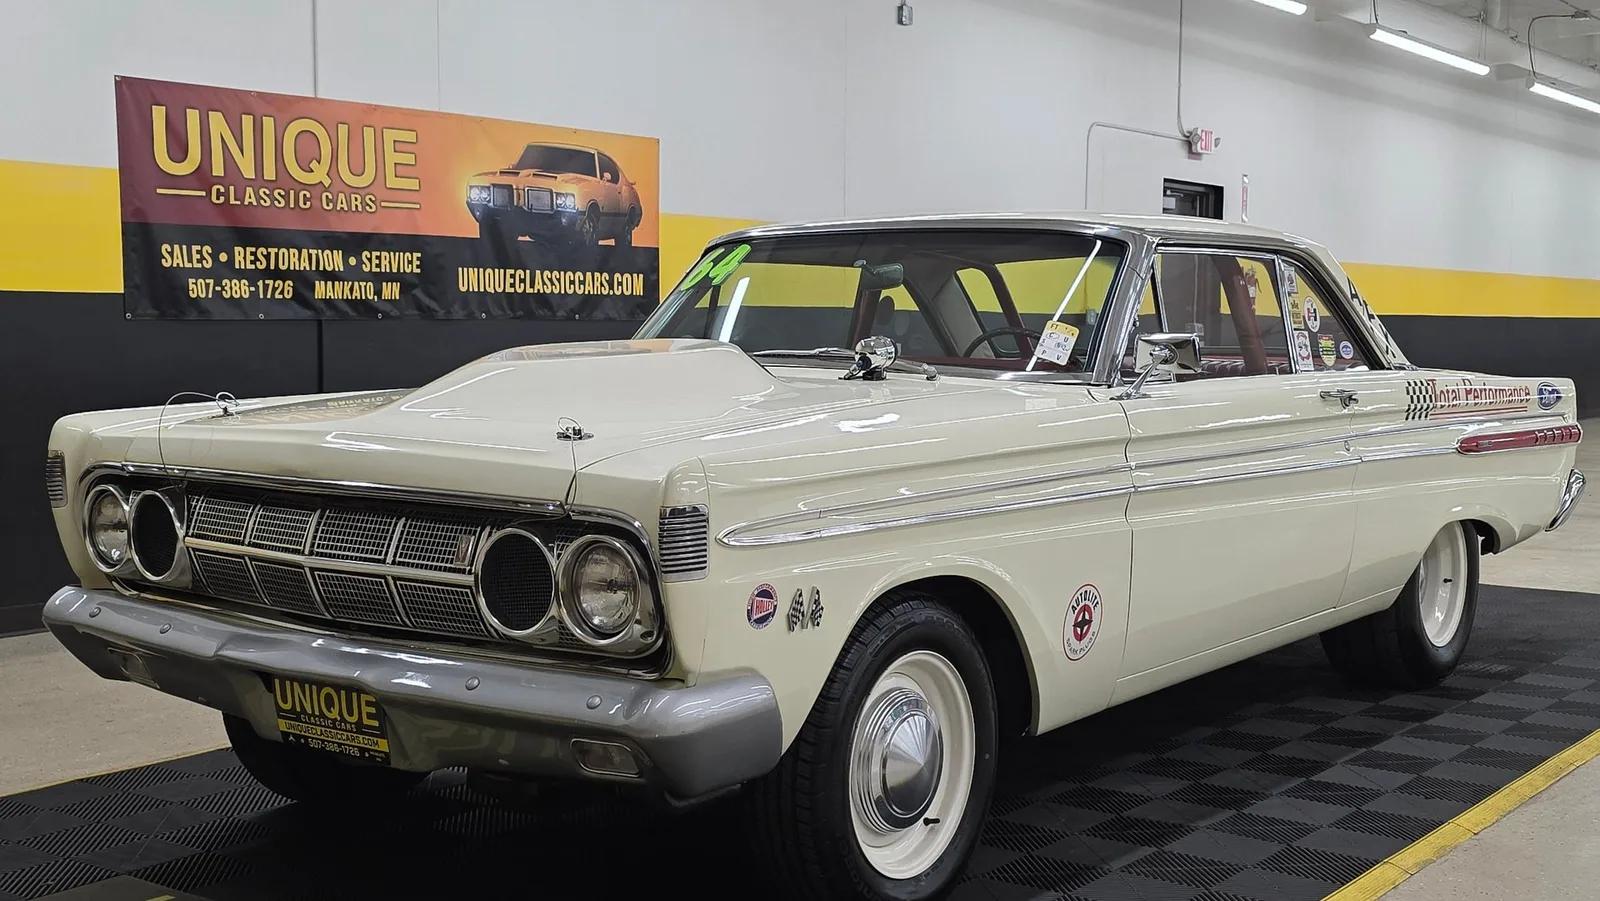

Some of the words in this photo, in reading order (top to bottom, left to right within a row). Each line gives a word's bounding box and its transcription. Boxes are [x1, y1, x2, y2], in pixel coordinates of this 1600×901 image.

[151, 104, 421, 190] UNIQUE
[210, 184, 311, 210] CLASSIC
[321, 191, 377, 213] CARS
[161, 243, 213, 269] SALES
[234, 246, 344, 272] RESTORATION
[361, 250, 422, 273] SERVICE
[187, 278, 294, 300] 507-386-1726
[314, 280, 378, 302] MANKATO,
[381, 281, 400, 300] MN
[457, 266, 644, 296] UNIQUECLASSICCARS.COM
[1071, 590, 1099, 614] AUTOLITE
[274, 679, 379, 727] UNIQUE
[284, 721, 380, 748] UNIQUECLASSICCARS.COM
[301, 715, 333, 727] CLASSIC
[335, 722, 357, 732] CARS
